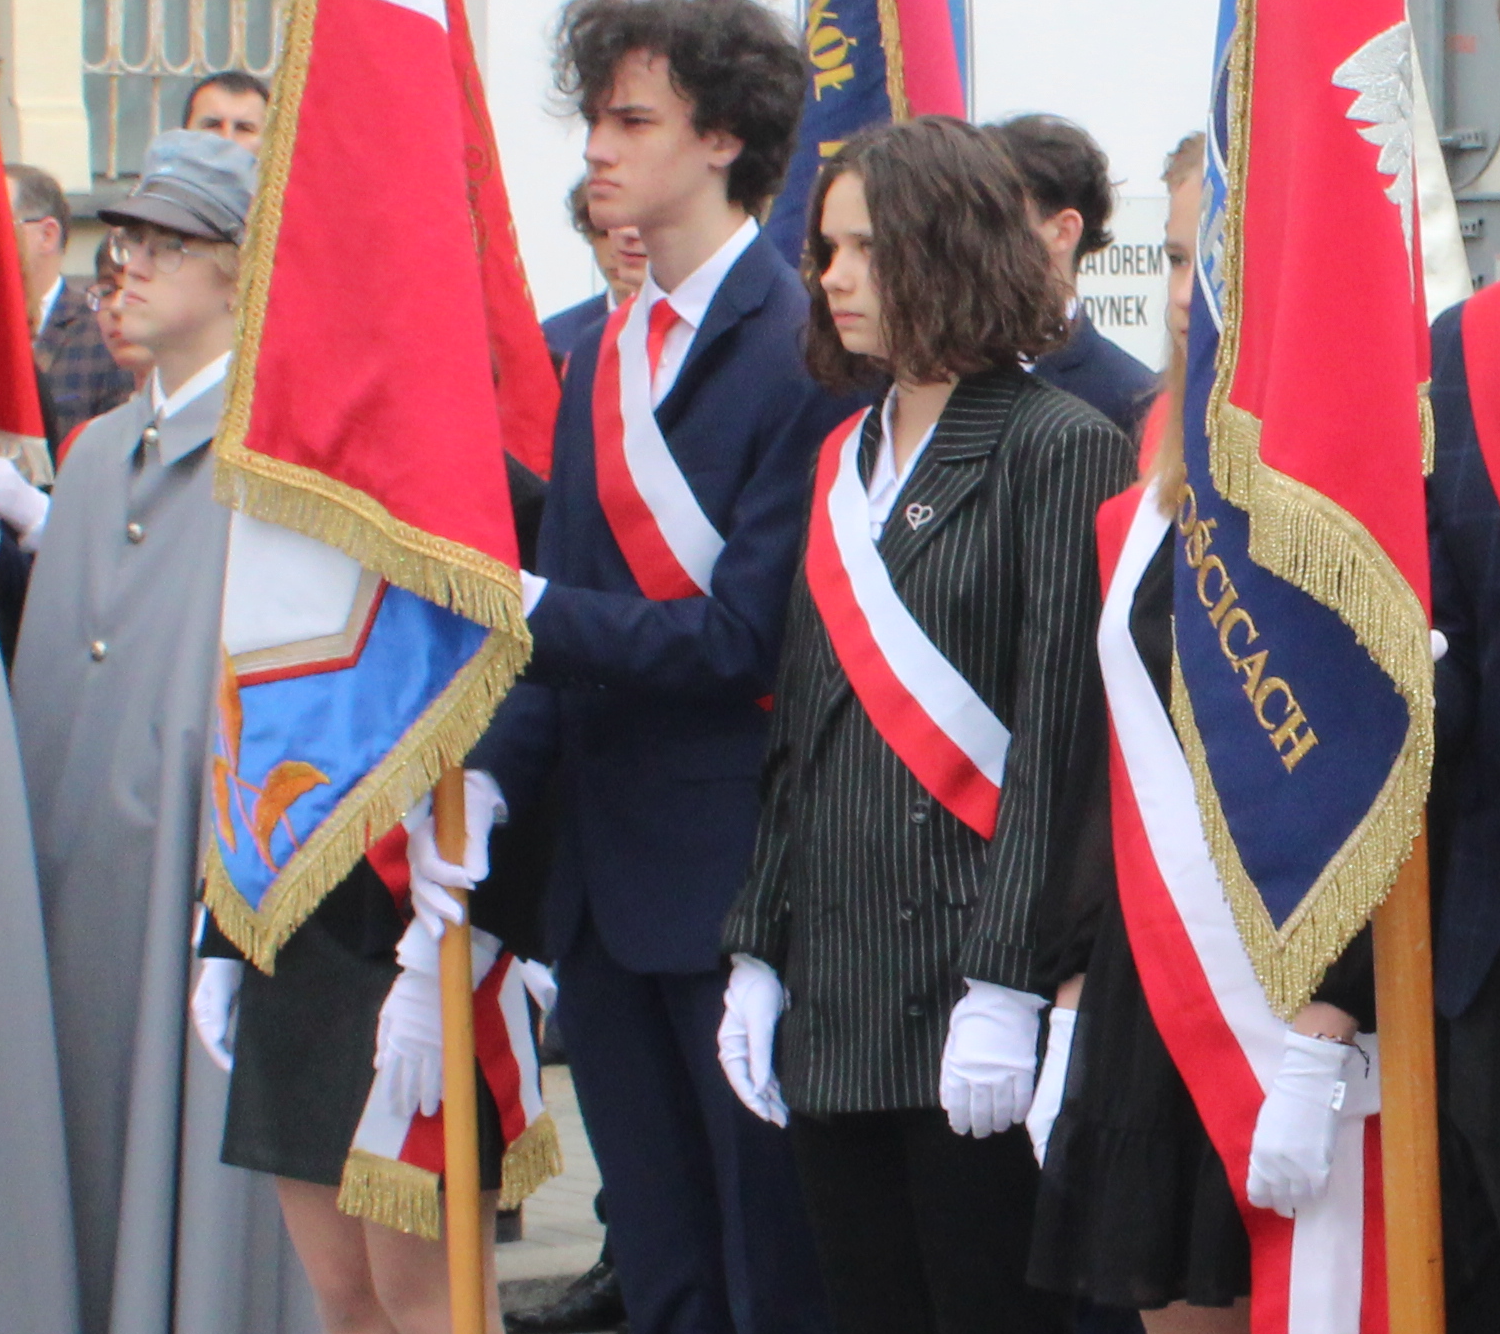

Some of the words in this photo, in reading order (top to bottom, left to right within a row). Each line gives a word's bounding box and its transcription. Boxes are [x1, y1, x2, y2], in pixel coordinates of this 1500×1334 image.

[1079, 243, 1164, 275] ATOREM
[1082, 294, 1149, 327] DYNEK
[1176, 483, 1320, 775] OŚCICACH
